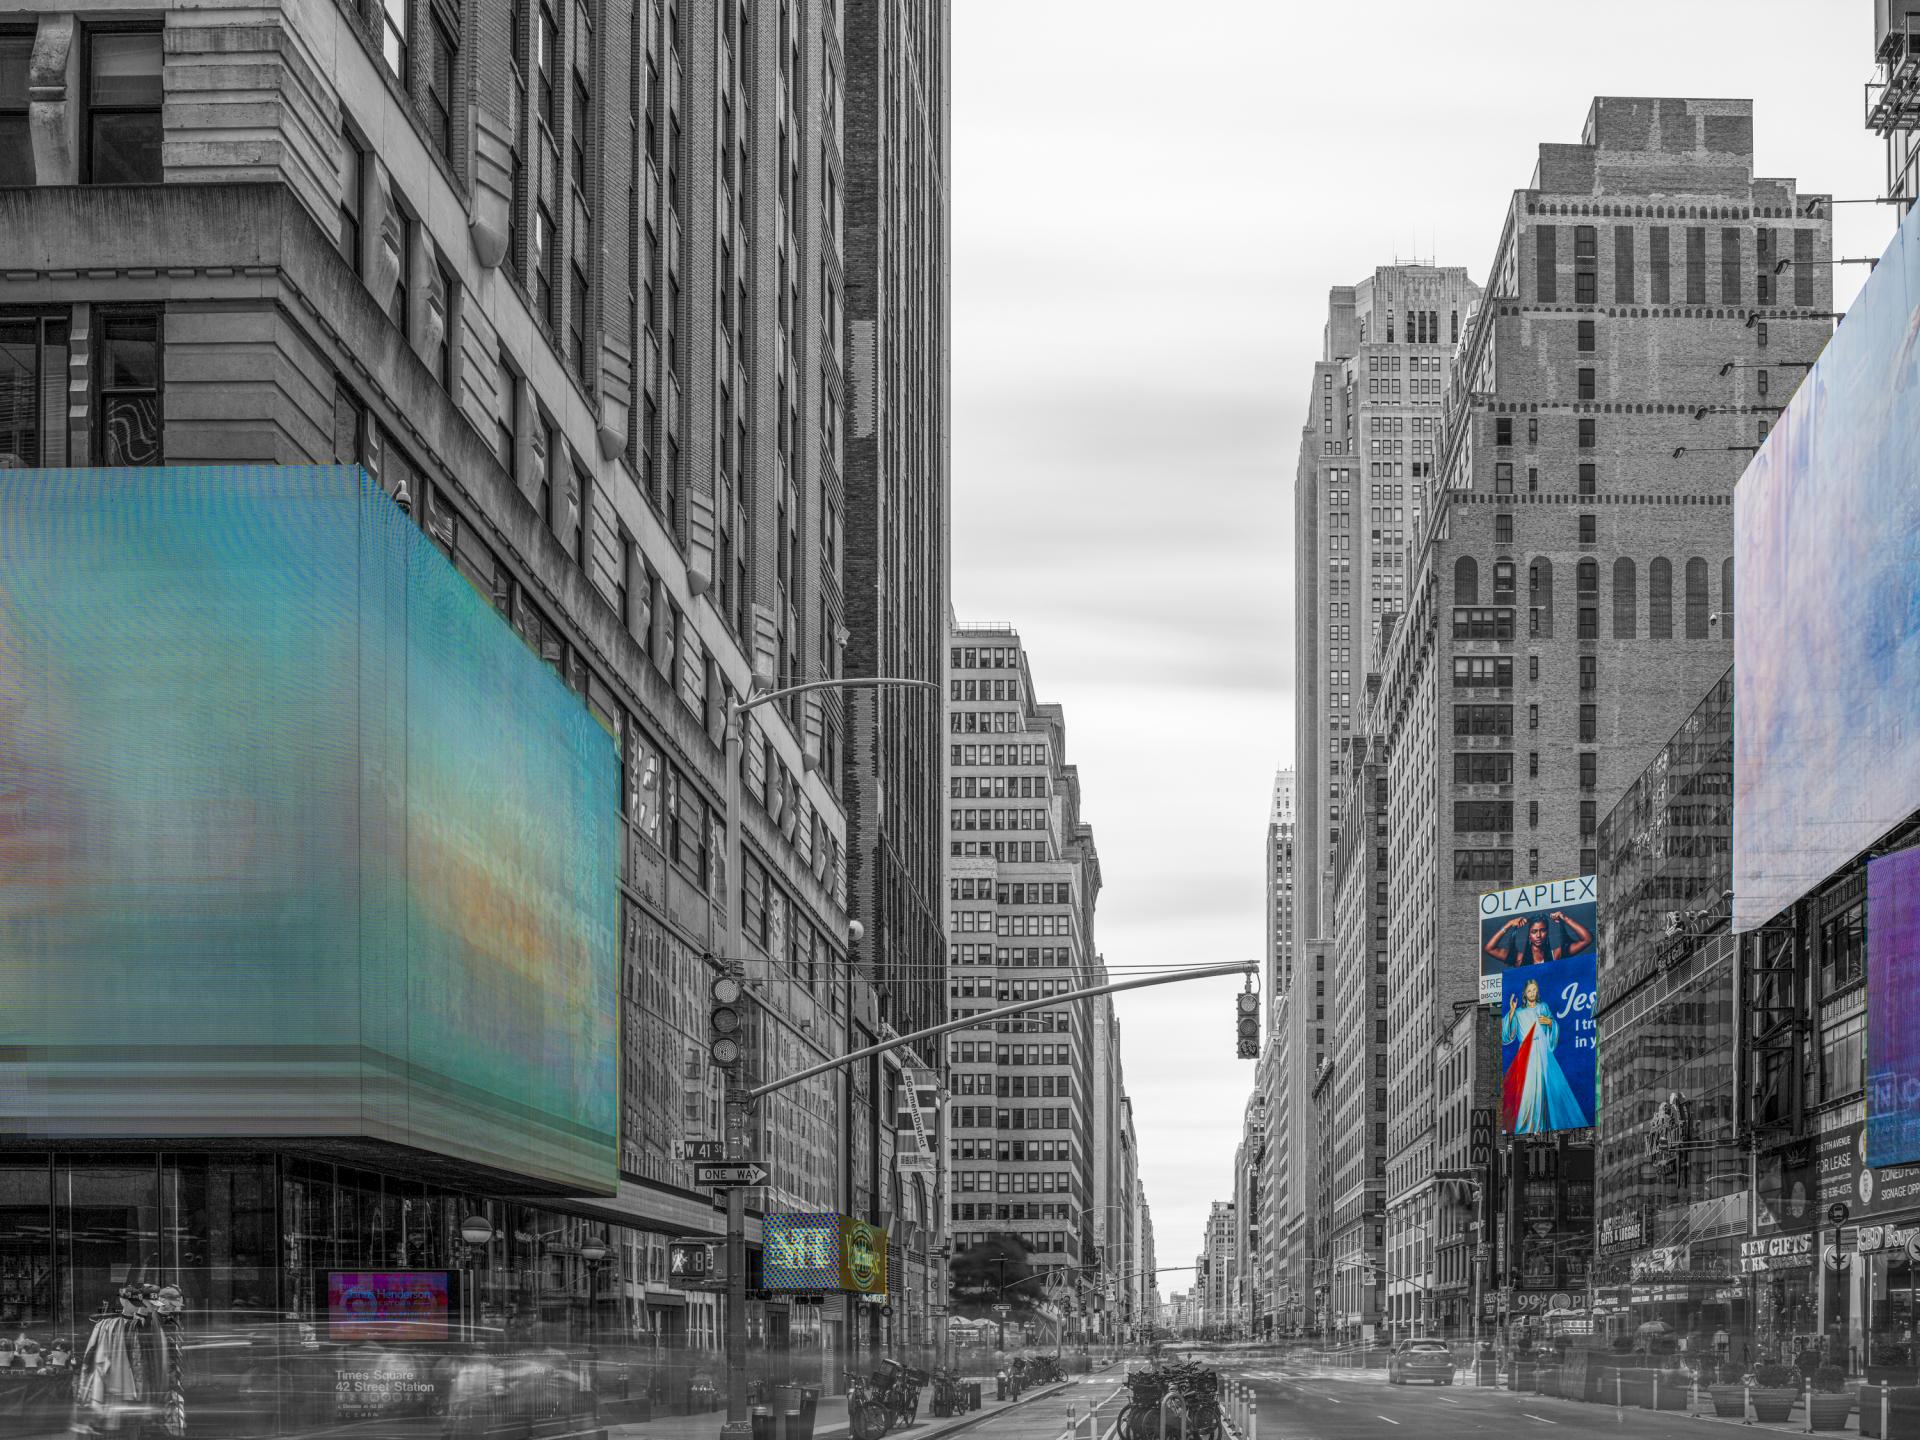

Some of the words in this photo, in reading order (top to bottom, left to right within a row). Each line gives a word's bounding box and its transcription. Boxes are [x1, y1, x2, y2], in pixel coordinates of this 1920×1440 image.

[1481, 876, 1596, 914] OLAPLEX
[1575, 1036, 1588, 1048] in
[904, 1075, 927, 1149] #GarmentDistrict
[1832, 1135, 1851, 1149] AVENUE
[685, 1143, 695, 1158] W
[699, 1143, 711, 1158] 41
[1815, 1157, 1829, 1174] FOR
[1830, 1152, 1852, 1171] LEASE
[705, 1169, 727, 1180] ONE
[737, 1169, 760, 1180] WAY
[1881, 1185, 1907, 1201] SIGNAGE
[1741, 1239, 1769, 1257] NEW
[1769, 1233, 1812, 1257] GIFTS
[1858, 1225, 1884, 1251] CBD
[377, 1288, 431, 1300] Henderson
[335, 1370, 369, 1380] Times
[374, 1370, 414, 1382] Square
[335, 1381, 350, 1392] 42
[355, 1381, 390, 1392] Street
[394, 1381, 435, 1392] Station
